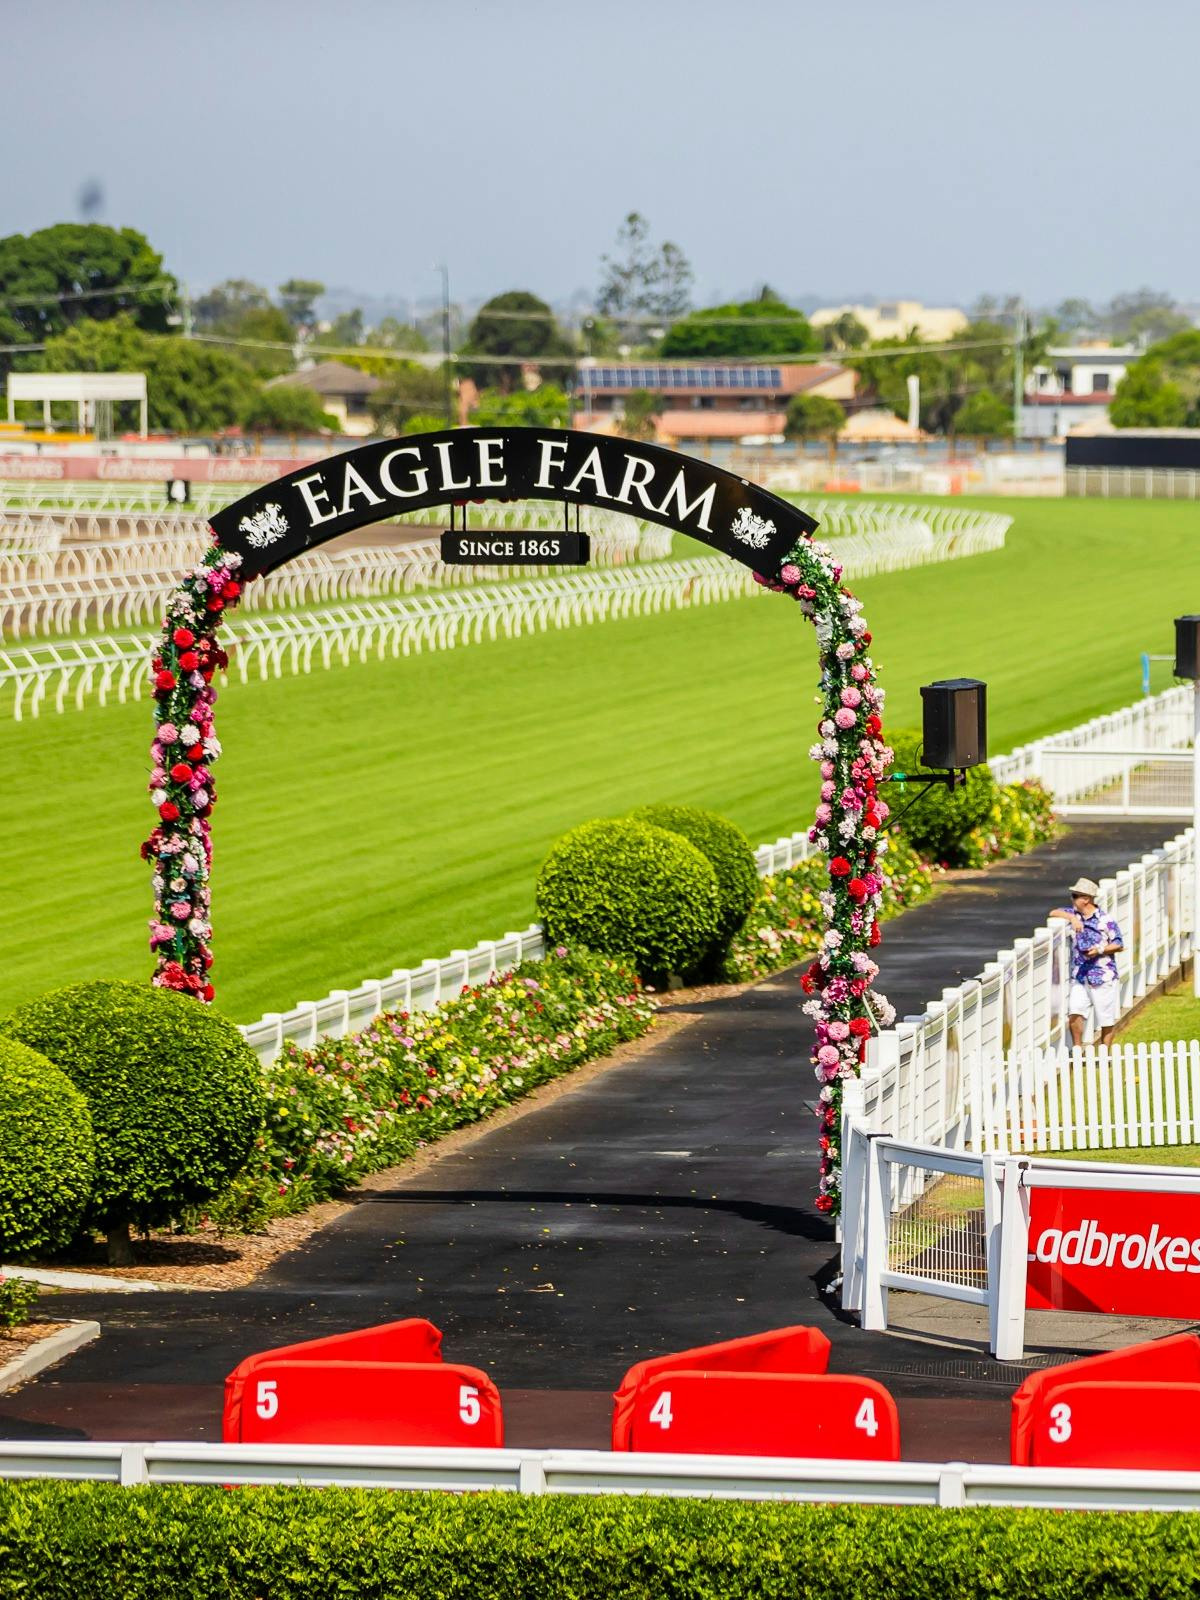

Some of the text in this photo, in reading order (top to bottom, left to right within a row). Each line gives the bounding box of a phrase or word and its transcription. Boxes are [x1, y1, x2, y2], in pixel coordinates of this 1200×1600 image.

[292, 438, 718, 533] EAGLE FARM
[460, 540, 559, 555] SINCE 1865
[257, 1382, 480, 1424] 5 5
[650, 1392, 878, 1436] 4 4
[1050, 1404, 1071, 1442] 3
